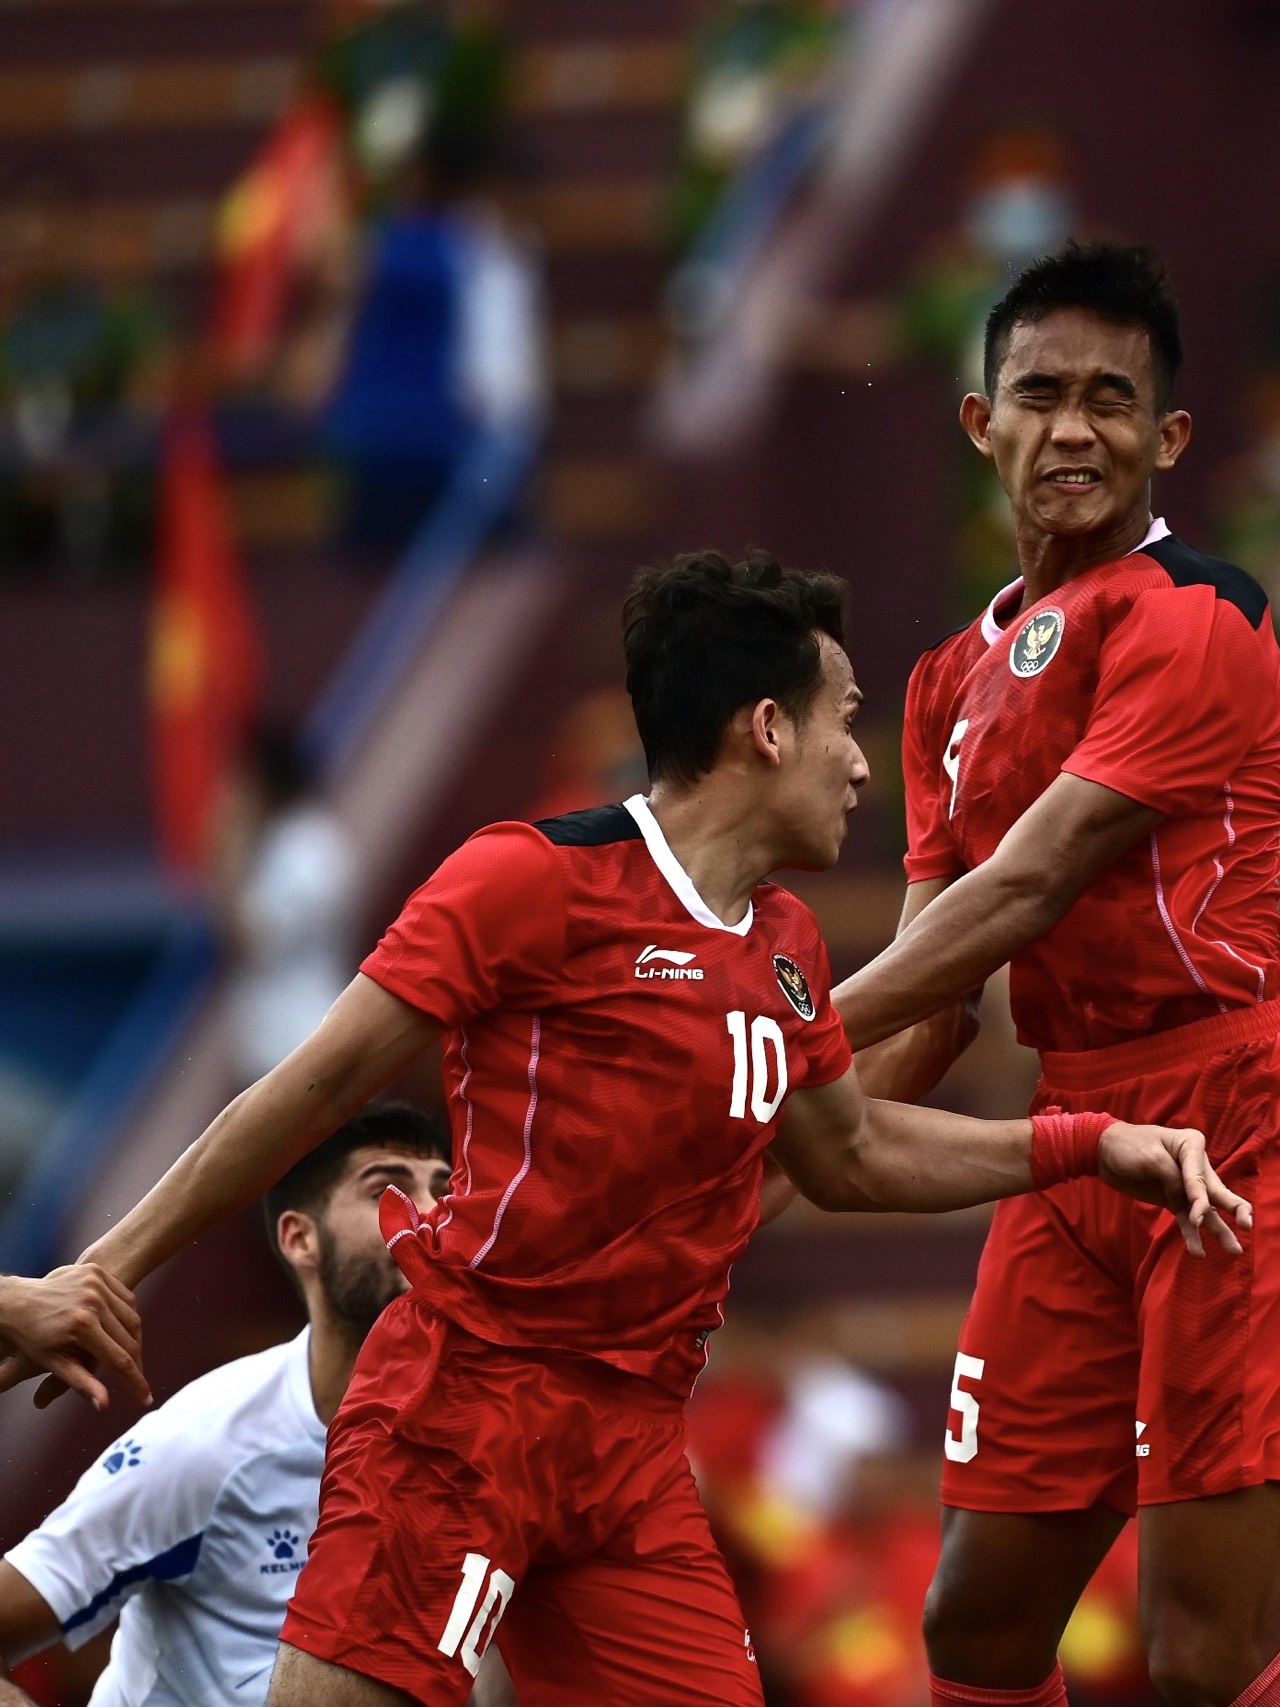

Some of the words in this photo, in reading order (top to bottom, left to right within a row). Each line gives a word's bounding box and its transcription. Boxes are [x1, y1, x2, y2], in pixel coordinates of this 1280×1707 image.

[634, 966, 705, 981] LI-NING
[726, 1009, 789, 1125] 10
[944, 1351, 986, 1464] 5
[437, 1551, 516, 1679] 10
